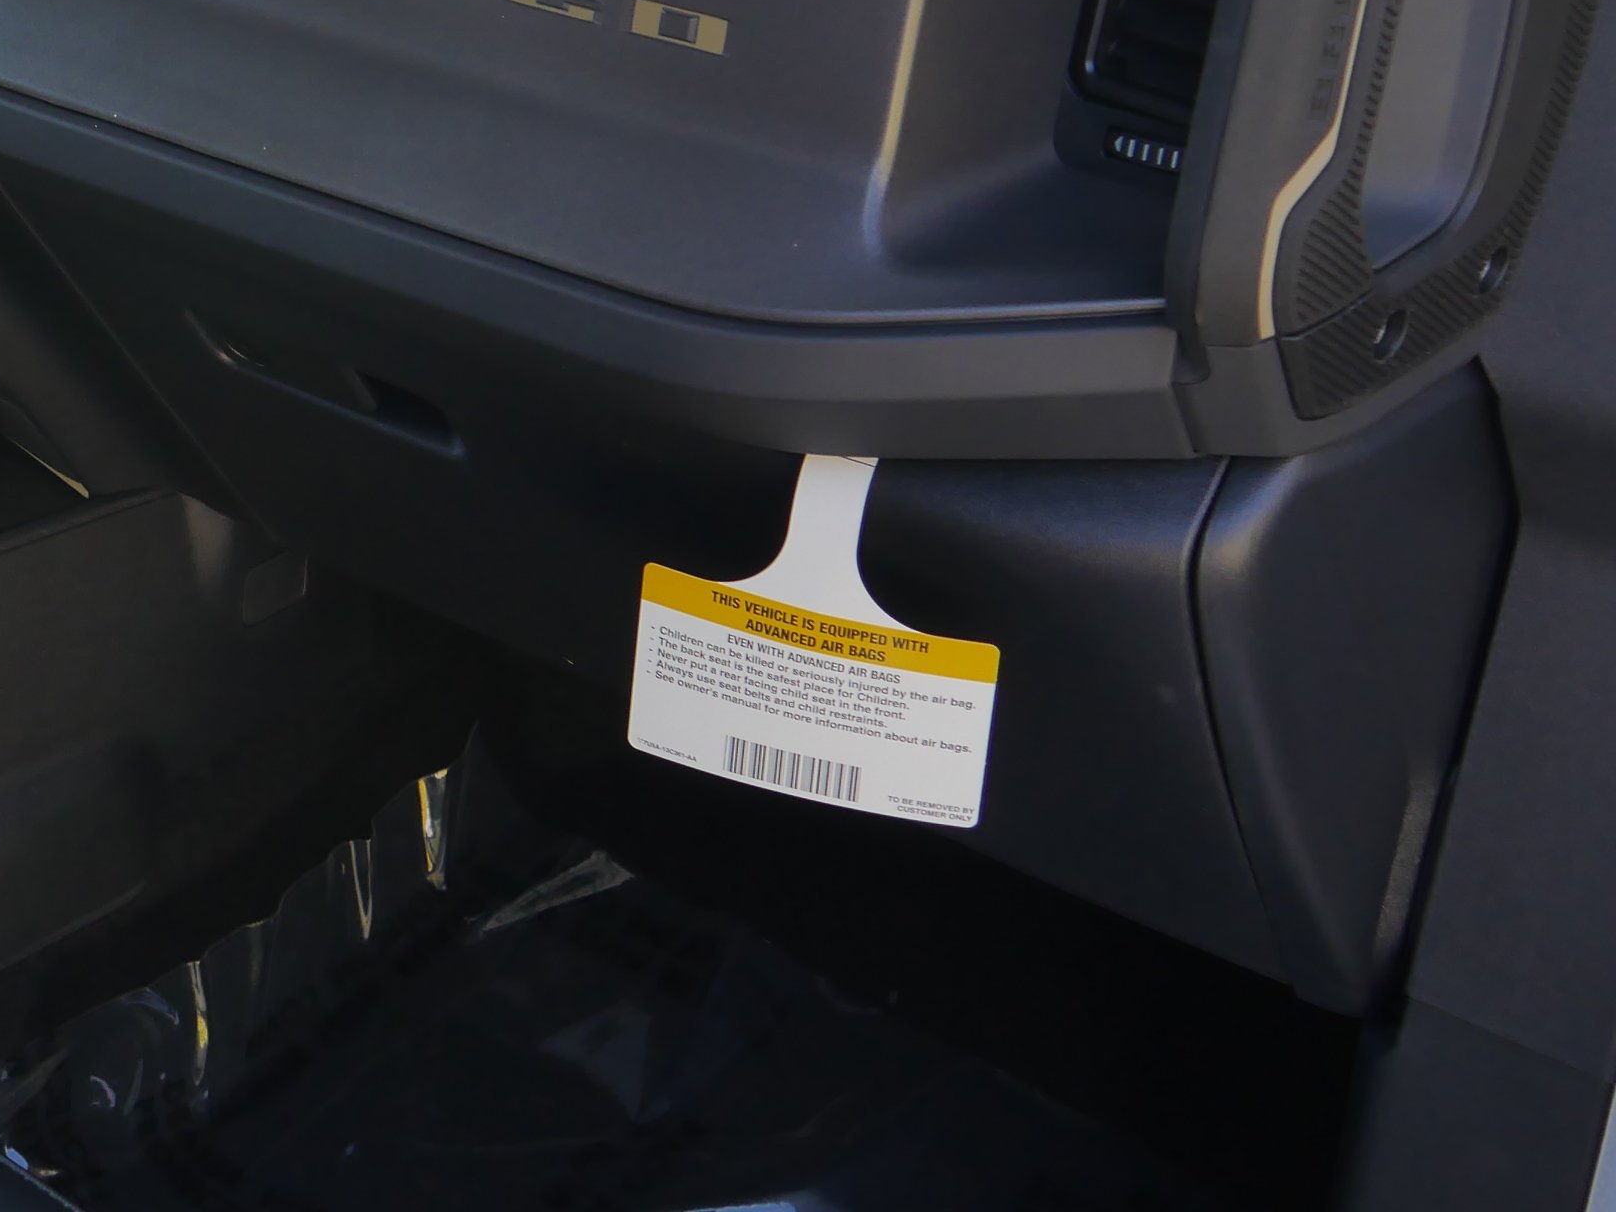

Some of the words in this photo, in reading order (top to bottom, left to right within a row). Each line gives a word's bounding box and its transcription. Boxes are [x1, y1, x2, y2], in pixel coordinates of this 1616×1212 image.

[711, 590, 740, 610] THIS
[745, 601, 798, 626] VEHICLE
[802, 617, 815, 631] IS
[820, 622, 887, 646] EQUIPPED
[892, 637, 929, 653] WITH
[745, 619, 816, 647] ADVANCED
[820, 640, 844, 654] AIR
[849, 645, 886, 662] BAGS
[658, 648, 687, 665] Never
[690, 660, 708, 673] put
[720, 670, 741, 682] rear
[744, 676, 778, 694] facing
[781, 685, 809, 700] child
[812, 695, 836, 706] seat
[839, 700, 850, 710] in
[853, 703, 872, 714] the
[875, 707, 906, 720] front.
[659, 626, 704, 648] Children
[706, 643, 726, 654] can
[729, 648, 742, 659] be
[745, 653, 774, 669] killed
[777, 664, 789, 673] or
[792, 667, 845, 688] seriously
[848, 679, 889, 695] injured
[892, 688, 907, 699] by
[910, 691, 929, 702] the
[932, 695, 947, 705] air
[951, 698, 976, 711] bag.
[659, 637, 678, 650] The
[681, 645, 706, 659] back
[709, 655, 731, 667] seat
[735, 661, 743, 671] is
[747, 664, 764, 677] the
[767, 672, 800, 688] safest
[803, 681, 834, 695] place
[838, 689, 854, 699] for
[857, 692, 910, 710] Children.
[728, 633, 754, 650] EVEN
[757, 643, 785, 659] WITH
[787, 652, 845, 673] ADVANCED
[848, 666, 867, 678] AIR
[871, 670, 901, 684] BAGS
[655, 670, 675, 683] See
[677, 679, 719, 698] owner's
[721, 693, 761, 711] manual
[764, 704, 780, 715] for
[782, 710, 812, 724] more
[815, 716, 881, 738] information
[884, 732, 919, 745] about
[921, 738, 937, 747] air
[940, 740, 972, 753] bags.
[657, 659, 693, 679] Always
[697, 674, 715, 685] use
[719, 680, 741, 694] seat
[744, 687, 771, 702] belts
[774, 695, 795, 708] and
[798, 702, 826, 716] child
[829, 710, 887, 728] restraints.
[897, 806, 947, 818] CUSTOMER
[949, 814, 972, 822] ONLY
[916, 800, 960, 812] REMOVED
